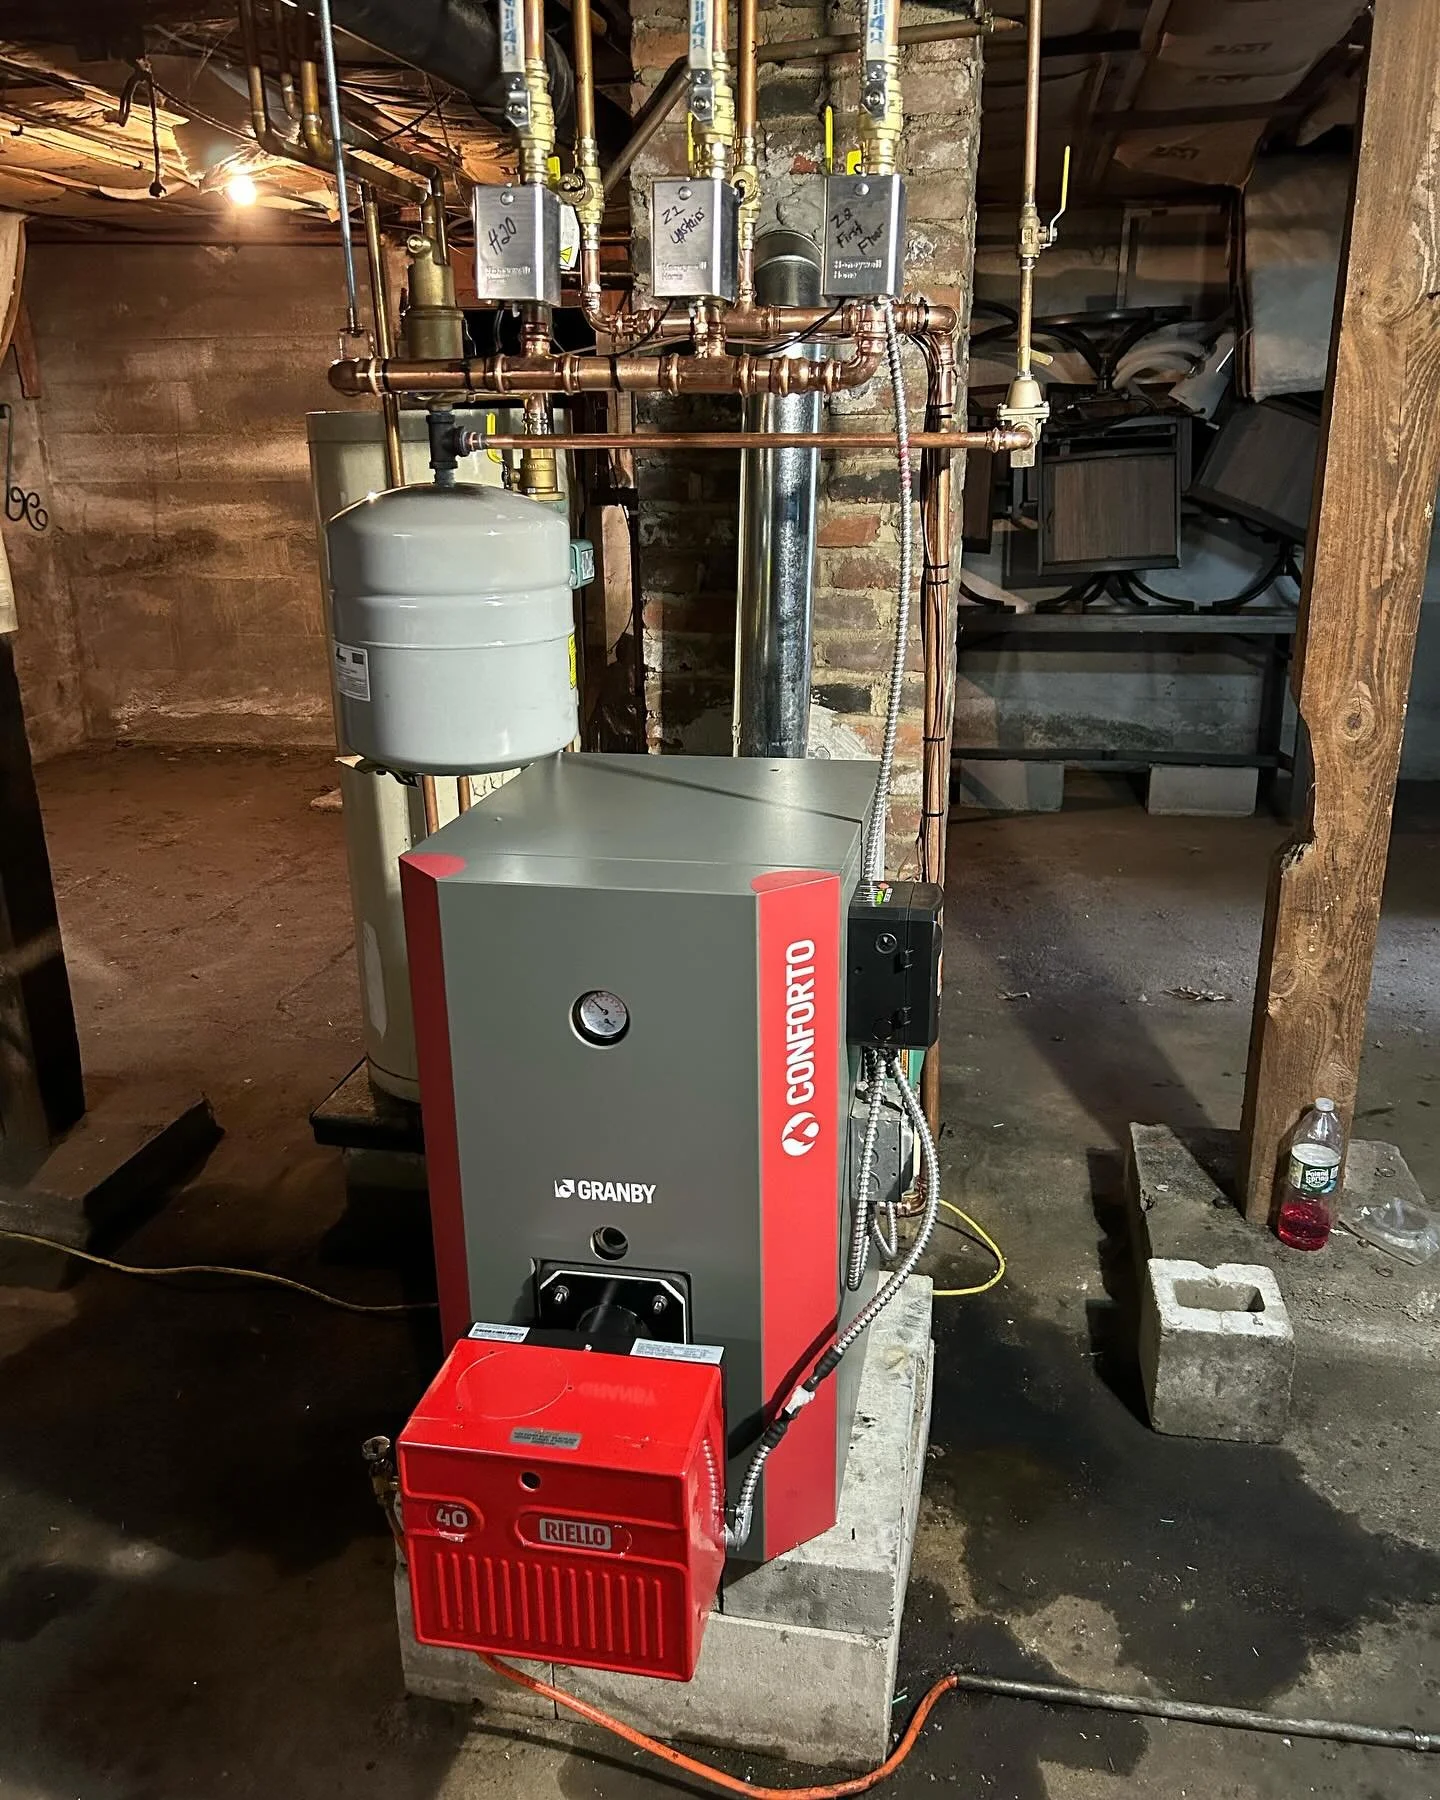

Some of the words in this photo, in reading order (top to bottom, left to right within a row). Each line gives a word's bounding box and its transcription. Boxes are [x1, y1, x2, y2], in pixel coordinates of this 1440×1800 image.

[662, 205, 686, 225] Z1
[830, 207, 853, 229] Z2
[835, 220, 863, 249] First
[785, 938, 816, 1106] CONFORTO
[1305, 1169, 1329, 1178] Poland
[1305, 1176, 1329, 1185] Spring
[577, 1180, 657, 1204] GRANBY
[436, 1507, 469, 1528] 40
[544, 1520, 607, 1547] RIELLO
